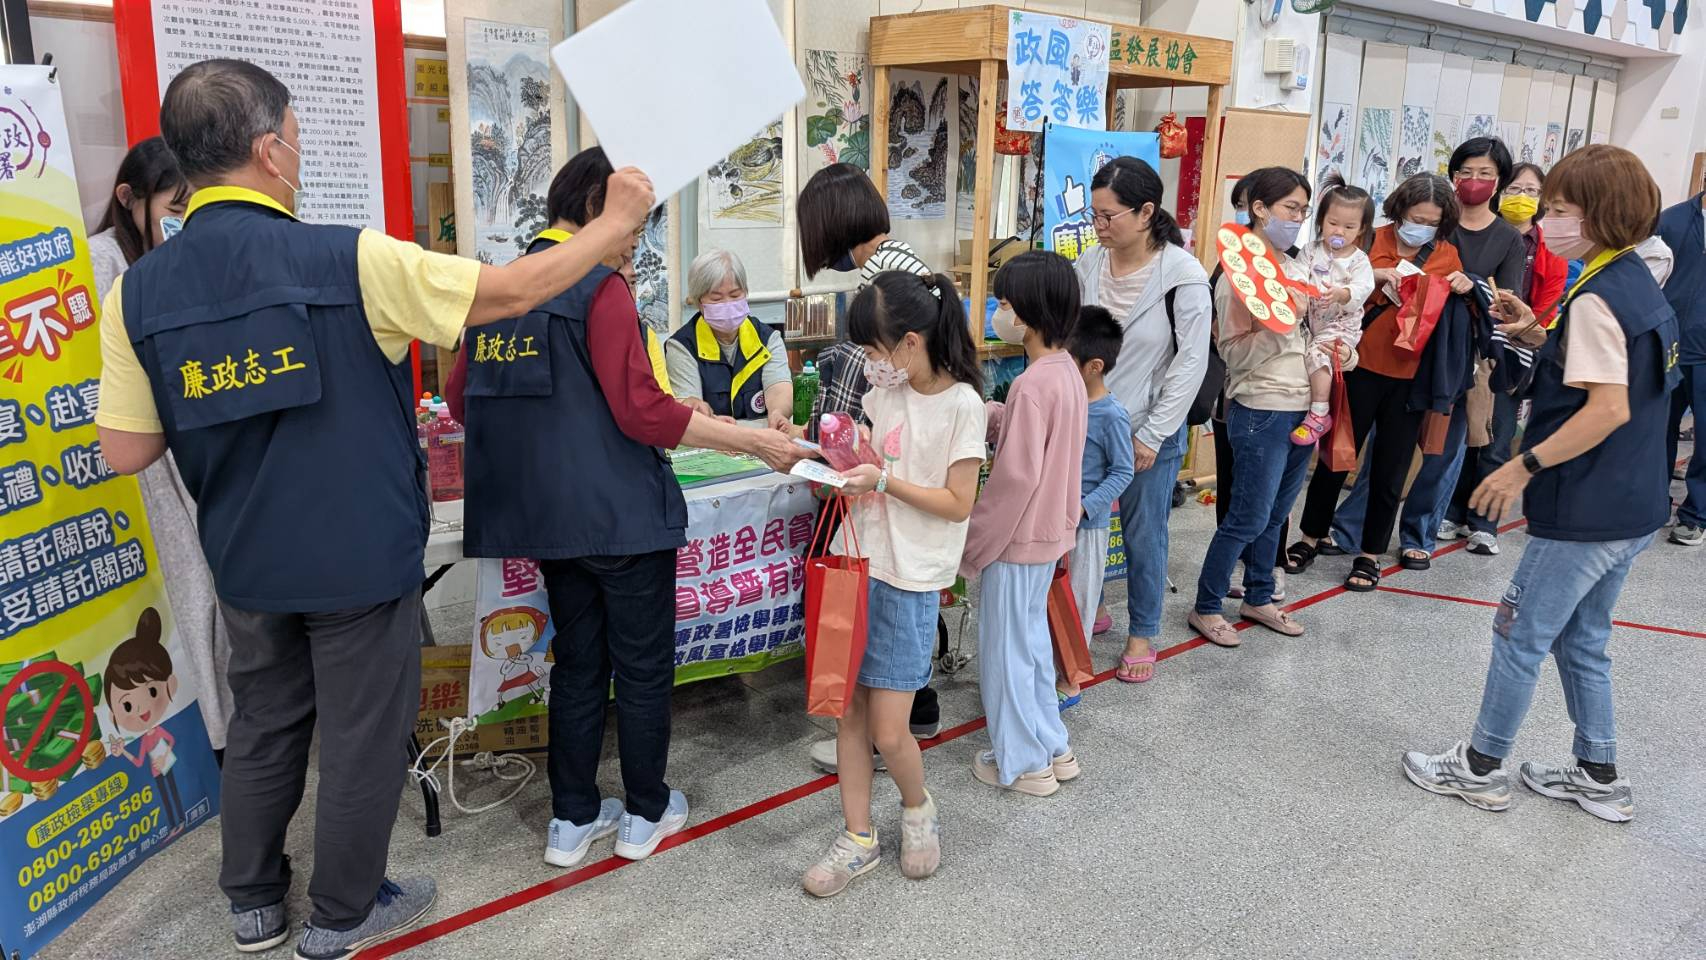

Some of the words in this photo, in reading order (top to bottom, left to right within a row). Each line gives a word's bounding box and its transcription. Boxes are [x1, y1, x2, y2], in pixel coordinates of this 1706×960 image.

[1015, 27, 1070, 71] 政風
[1109, 32, 1198, 76] 區發展協會
[1020, 79, 1099, 124] 答答樂
[0, 123, 28, 149] 政
[0, 233, 71, 278] 能好政府
[474, 332, 539, 362] 廉政志工
[179, 346, 306, 399] 廉政志工
[0, 446, 117, 510] 禮、收
[0, 541, 146, 636] 受請託關說
[674, 624, 805, 666] 風室檢舉專線
[36, 776, 123, 843] 廉政檢舉專線
[18, 785, 153, 888] 0800-286-586
[28, 807, 161, 913] 0800-692-007
